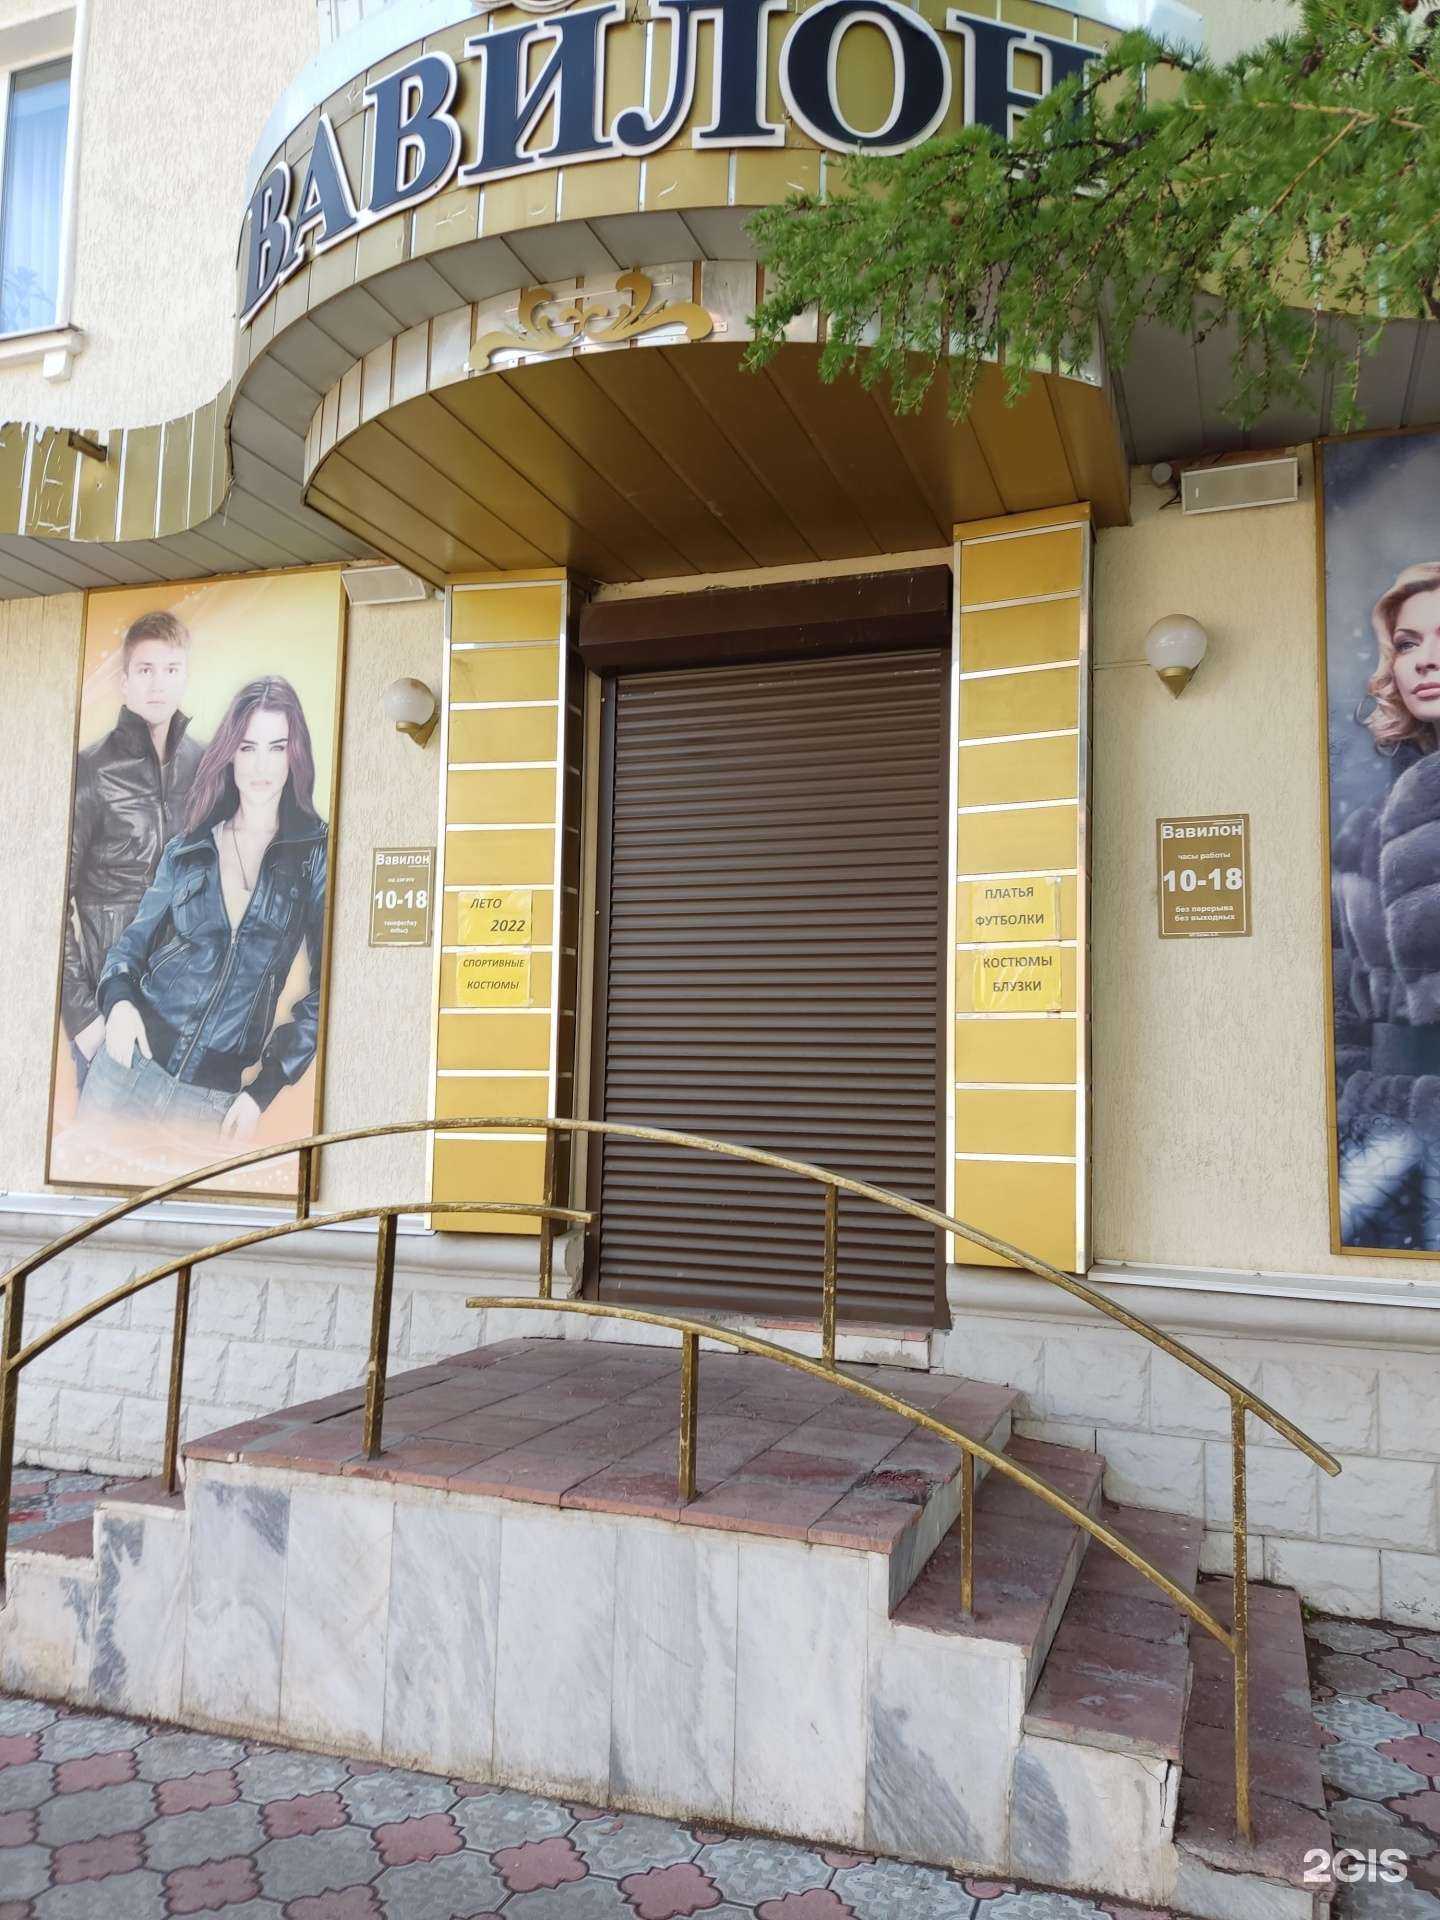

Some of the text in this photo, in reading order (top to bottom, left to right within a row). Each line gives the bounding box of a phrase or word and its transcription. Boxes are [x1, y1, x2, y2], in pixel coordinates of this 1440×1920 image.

[1162, 825, 1242, 839] Вавилон
[376, 854, 430, 866] Вавилон
[1200, 851, 1231, 860] работы
[1163, 867, 1243, 892] 10-18
[985, 887, 1034, 899] ПЛАТЬЯ
[375, 890, 428, 909] 10-18
[470, 898, 502, 909] ЛЕТО
[1175, 905, 1189, 913] без
[975, 914, 1044, 926] ФУТБОЛКИ
[1174, 914, 1189, 922] без
[490, 920, 526, 932] 2022
[463, 959, 525, 968] СПОРТИВНЫЕ
[983, 956, 1053, 968] КОСТЮМЫ
[467, 981, 519, 990] КОСТЮМЫ
[993, 981, 1042, 992] БЛУЗКИ
